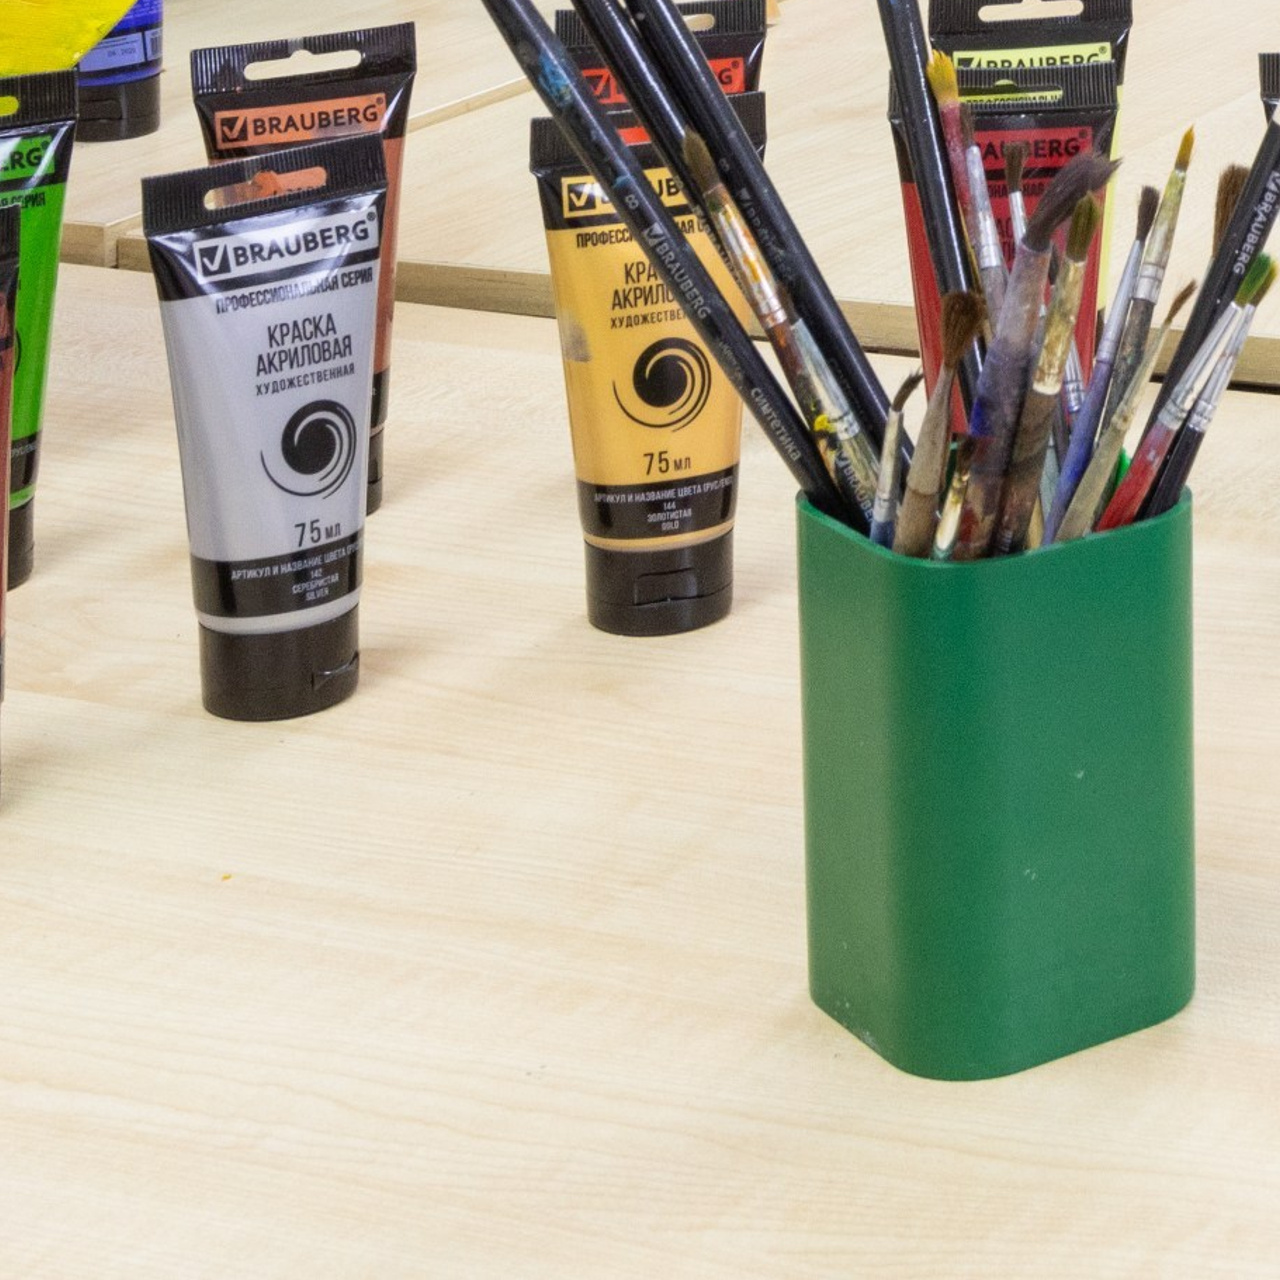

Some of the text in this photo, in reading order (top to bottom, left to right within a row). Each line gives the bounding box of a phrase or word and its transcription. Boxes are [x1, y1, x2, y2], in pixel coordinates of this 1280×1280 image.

[253, 104, 378, 136] BRAUBERG
[624, 194, 641, 210] 8
[233, 220, 370, 267] BRAUBERG
[1233, 185, 1280, 275] BRAUBERG
[624, 262, 658, 285] КРА
[656, 243, 712, 320] BRAUBERG
[216, 267, 373, 315] ПРОФЕССИОНАЛЬНАЯ СЕРИЯ
[267, 313, 337, 349] КРАСКА
[256, 335, 353, 377] АКРИЛОВАЯ
[255, 363, 355, 396] ХУДОЖЕСТВЕННАЯ
[643, 450, 670, 476] 75
[635, 488, 677, 503] НАЗВАНИЕ
[677, 483, 702, 498] ЦВЕТА
[294, 518, 322, 548] 75
[231, 567, 271, 581] АРТИКУЛ
[272, 566, 280, 576] И
[280, 555, 323, 575] НАЗВАНИЕ
[323, 547, 346, 564] ЦВЕТА
